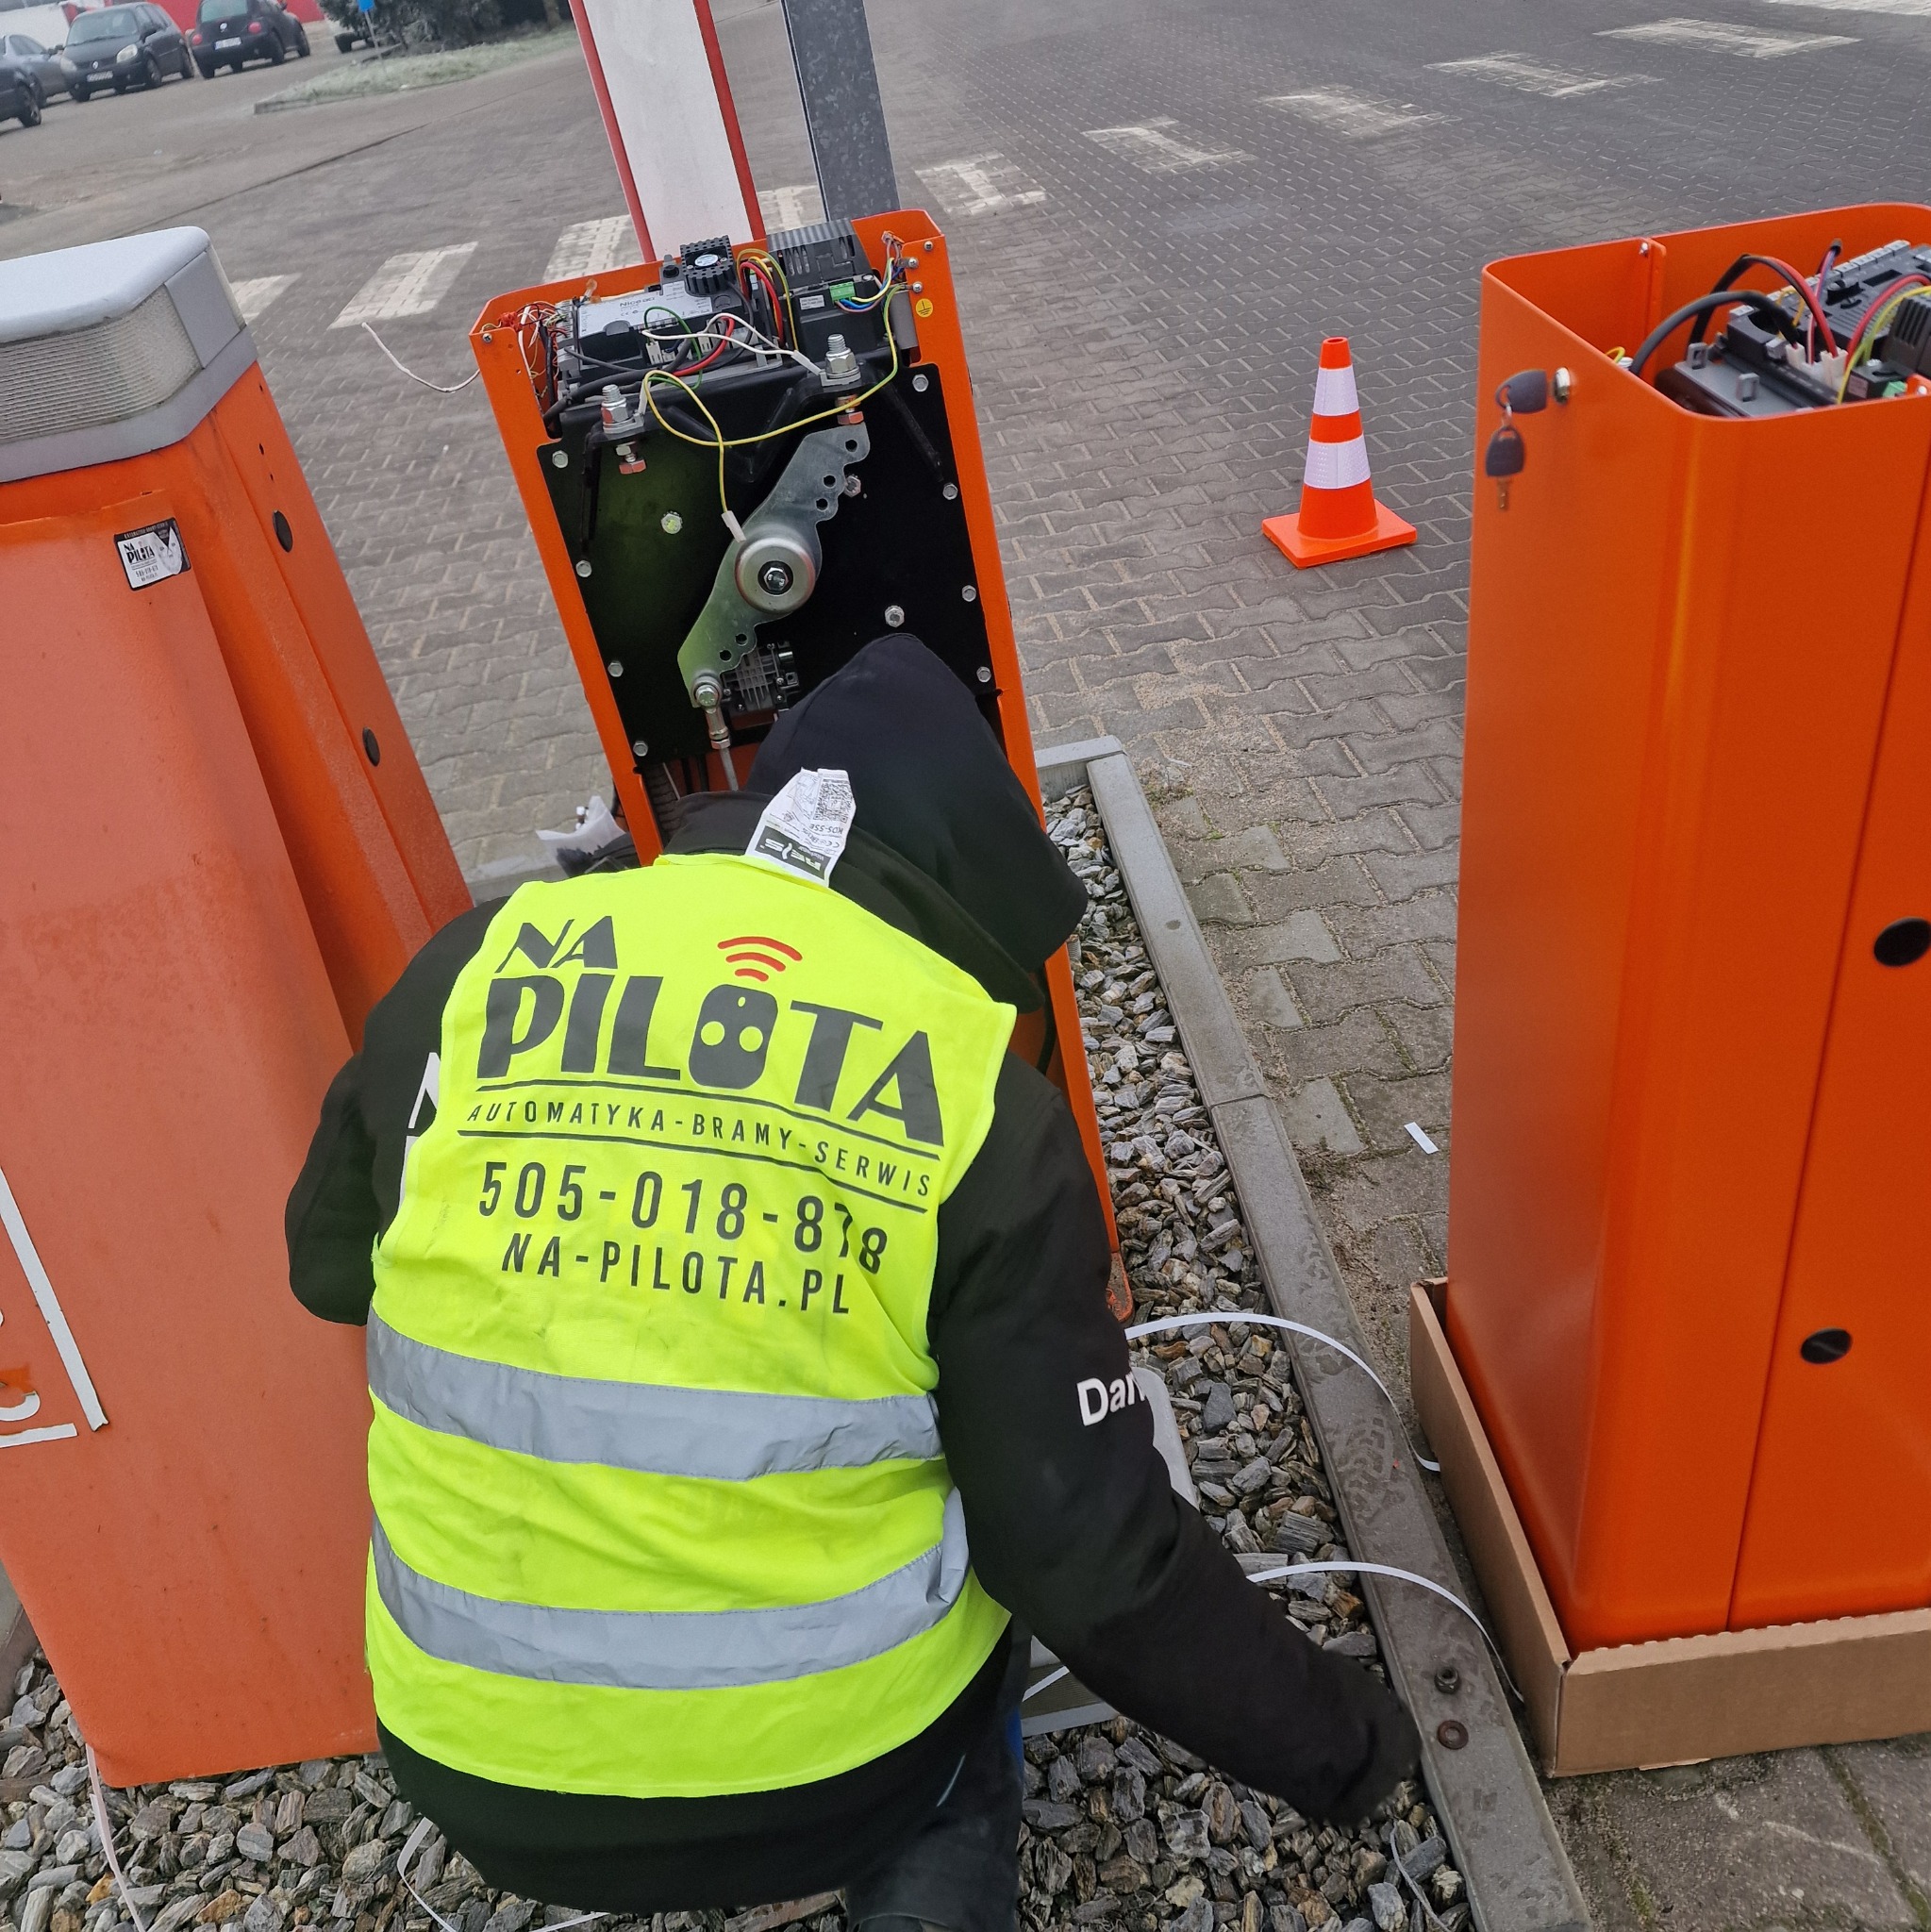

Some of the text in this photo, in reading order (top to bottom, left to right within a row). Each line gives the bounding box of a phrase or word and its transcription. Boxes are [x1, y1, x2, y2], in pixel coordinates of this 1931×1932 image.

[495, 915, 618, 973] NA
[476, 973, 944, 1146] PILOTA
[468, 1100, 930, 1197] AUTOMATYKA-BRAMY-SERWIS
[479, 1161, 887, 1274] 505-018-878
[502, 1233, 850, 1314] NA-PILOTA.PL
